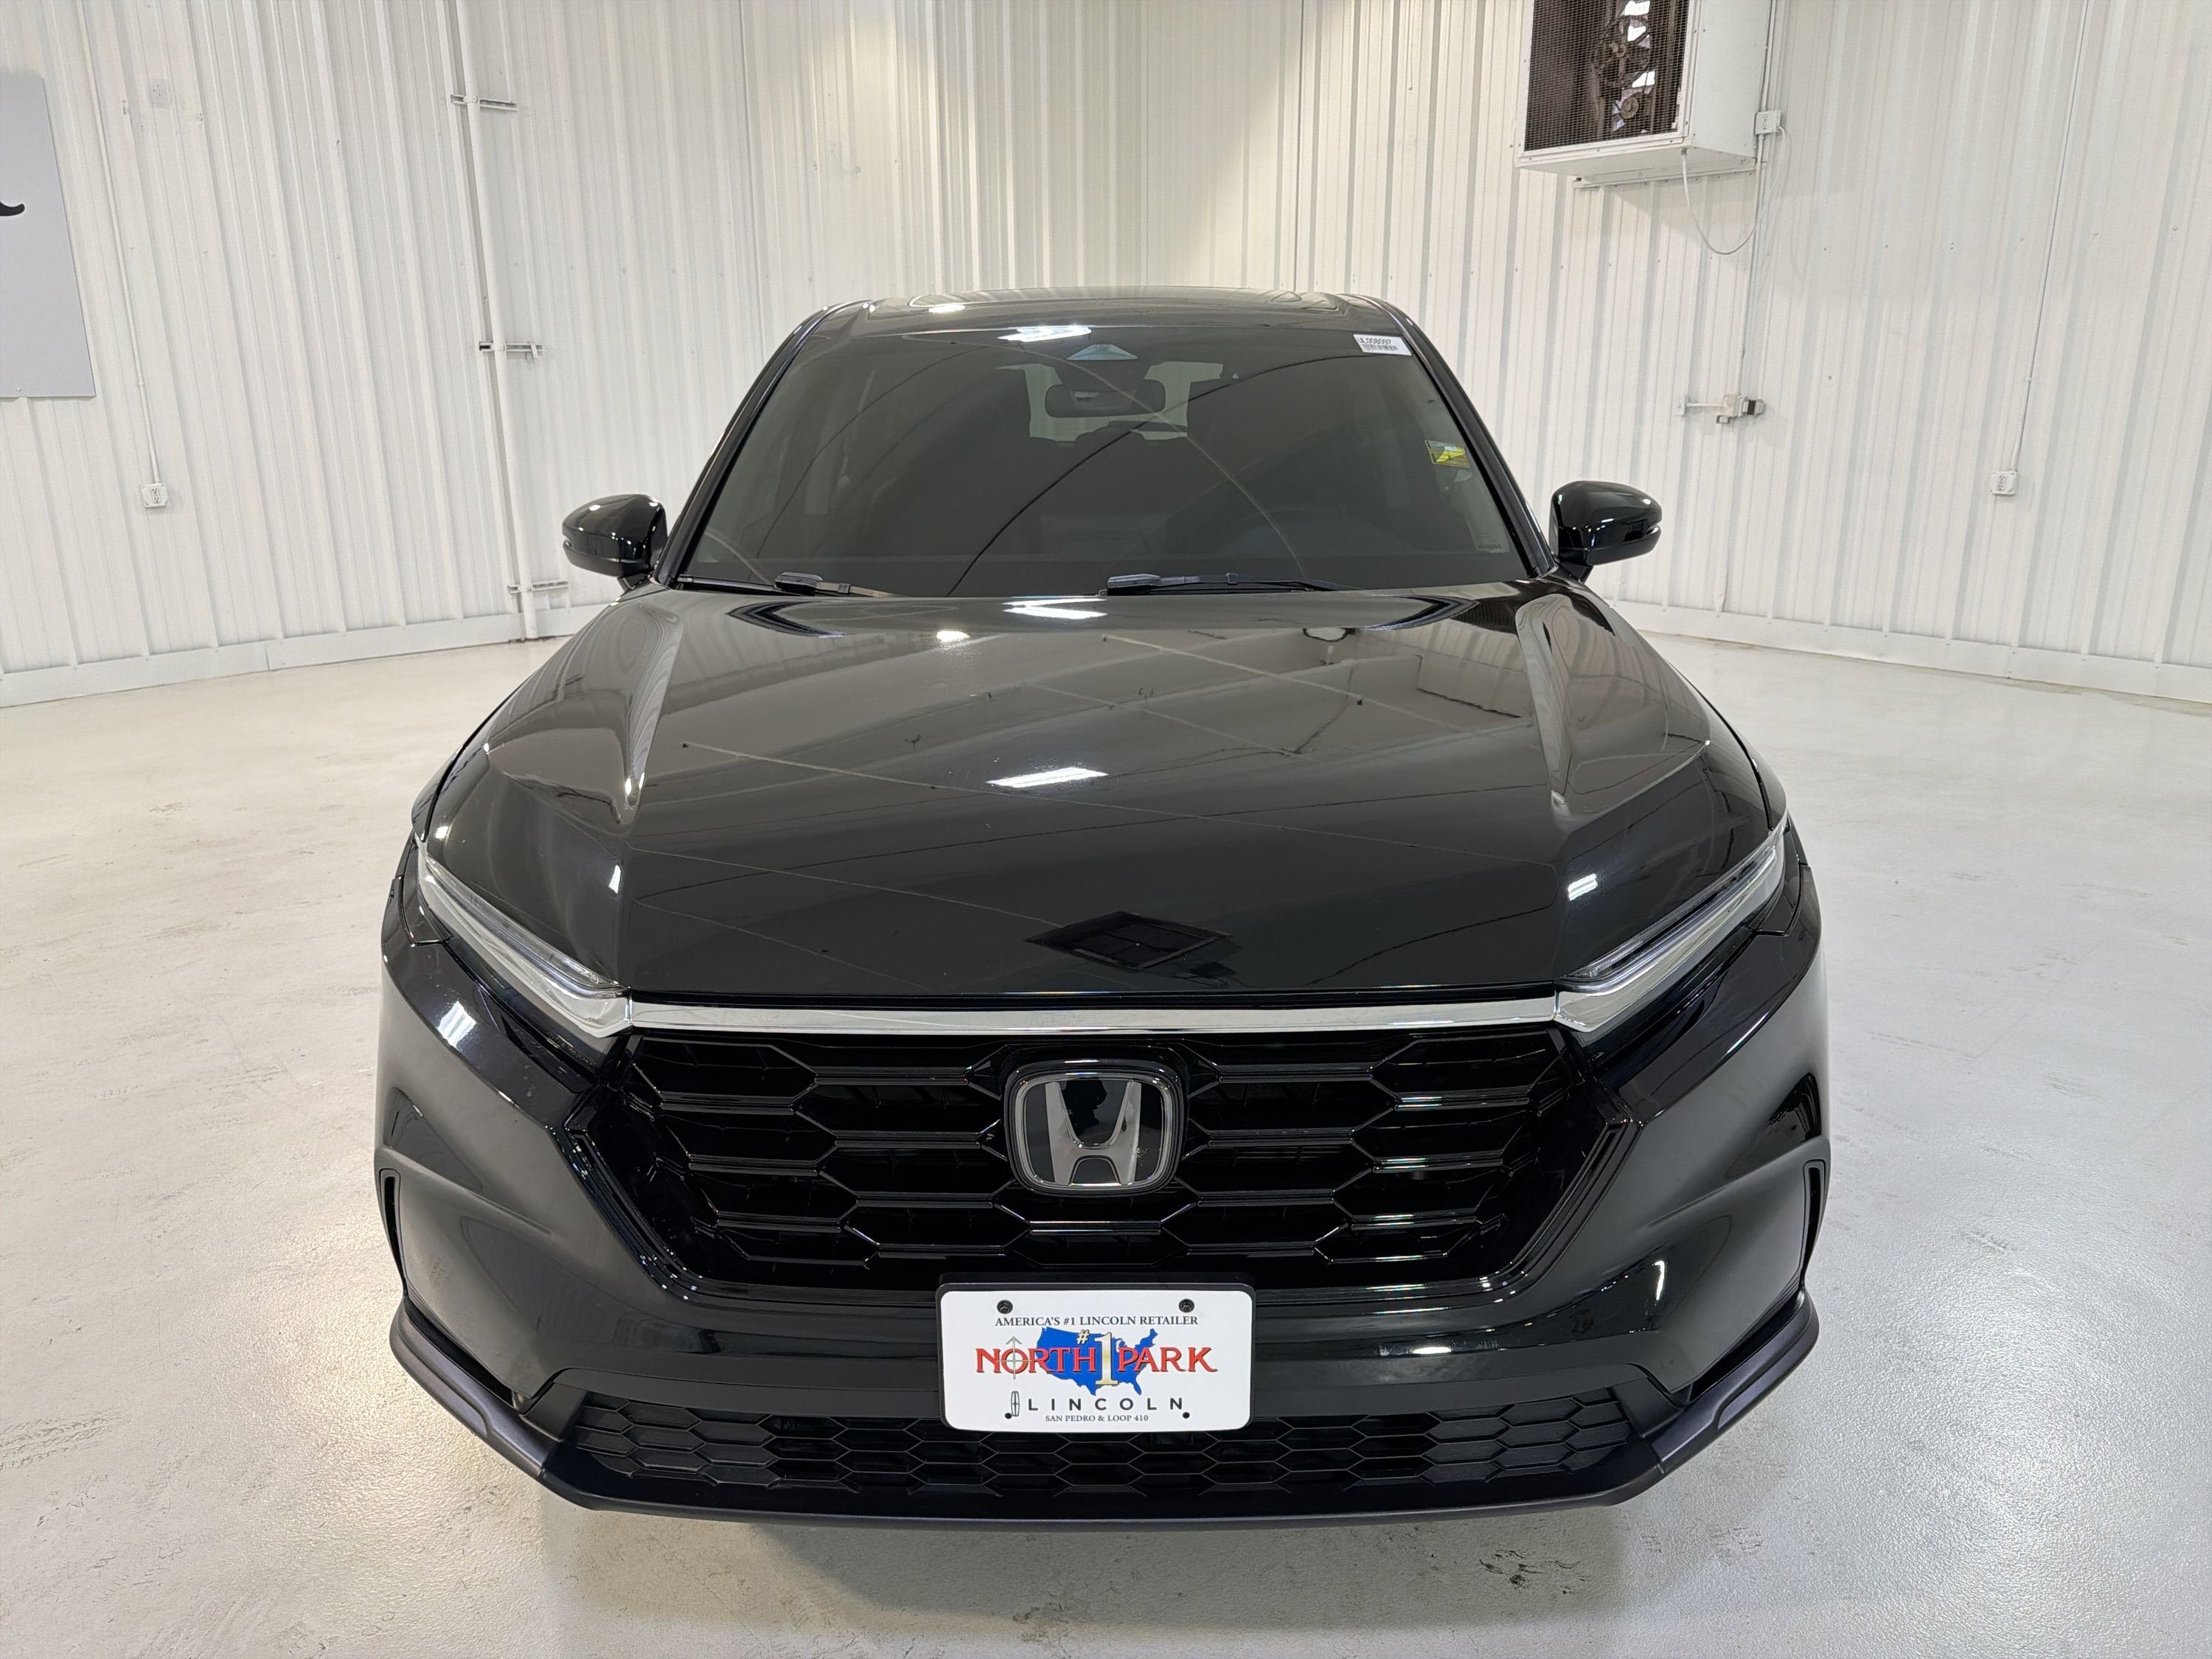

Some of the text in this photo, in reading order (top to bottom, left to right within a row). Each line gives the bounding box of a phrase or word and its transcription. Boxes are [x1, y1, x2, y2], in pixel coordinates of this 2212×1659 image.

[995, 1316, 1199, 1326] AMERICA'S #1 LINCOLN RETAILER
[975, 1347, 1098, 1374] NORTH
[1118, 1346, 1219, 1373] PARK
[1029, 1398, 1183, 1411] LINCOLN
